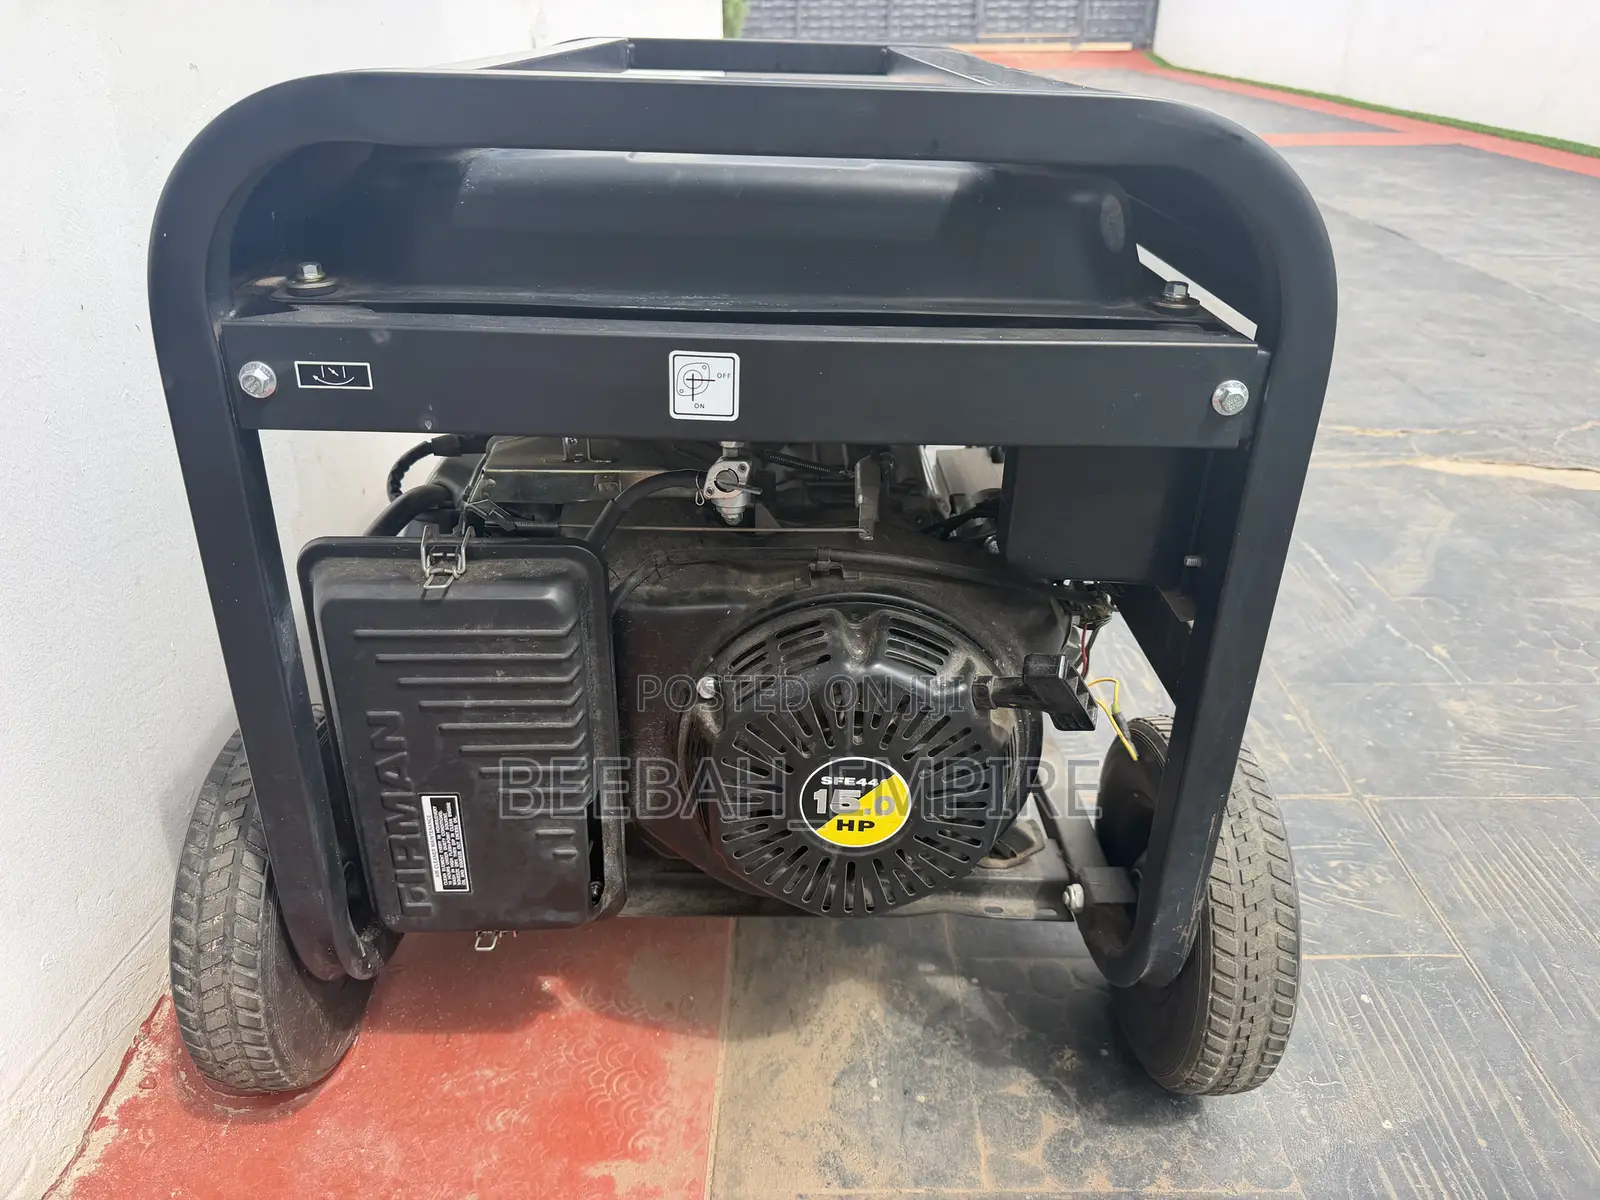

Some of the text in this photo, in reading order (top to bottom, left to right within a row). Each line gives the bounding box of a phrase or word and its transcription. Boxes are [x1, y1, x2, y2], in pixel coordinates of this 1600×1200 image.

[366, 710, 433, 918] FIRMAN
[813, 788, 896, 816] 15.0
[836, 819, 876, 832] HP
